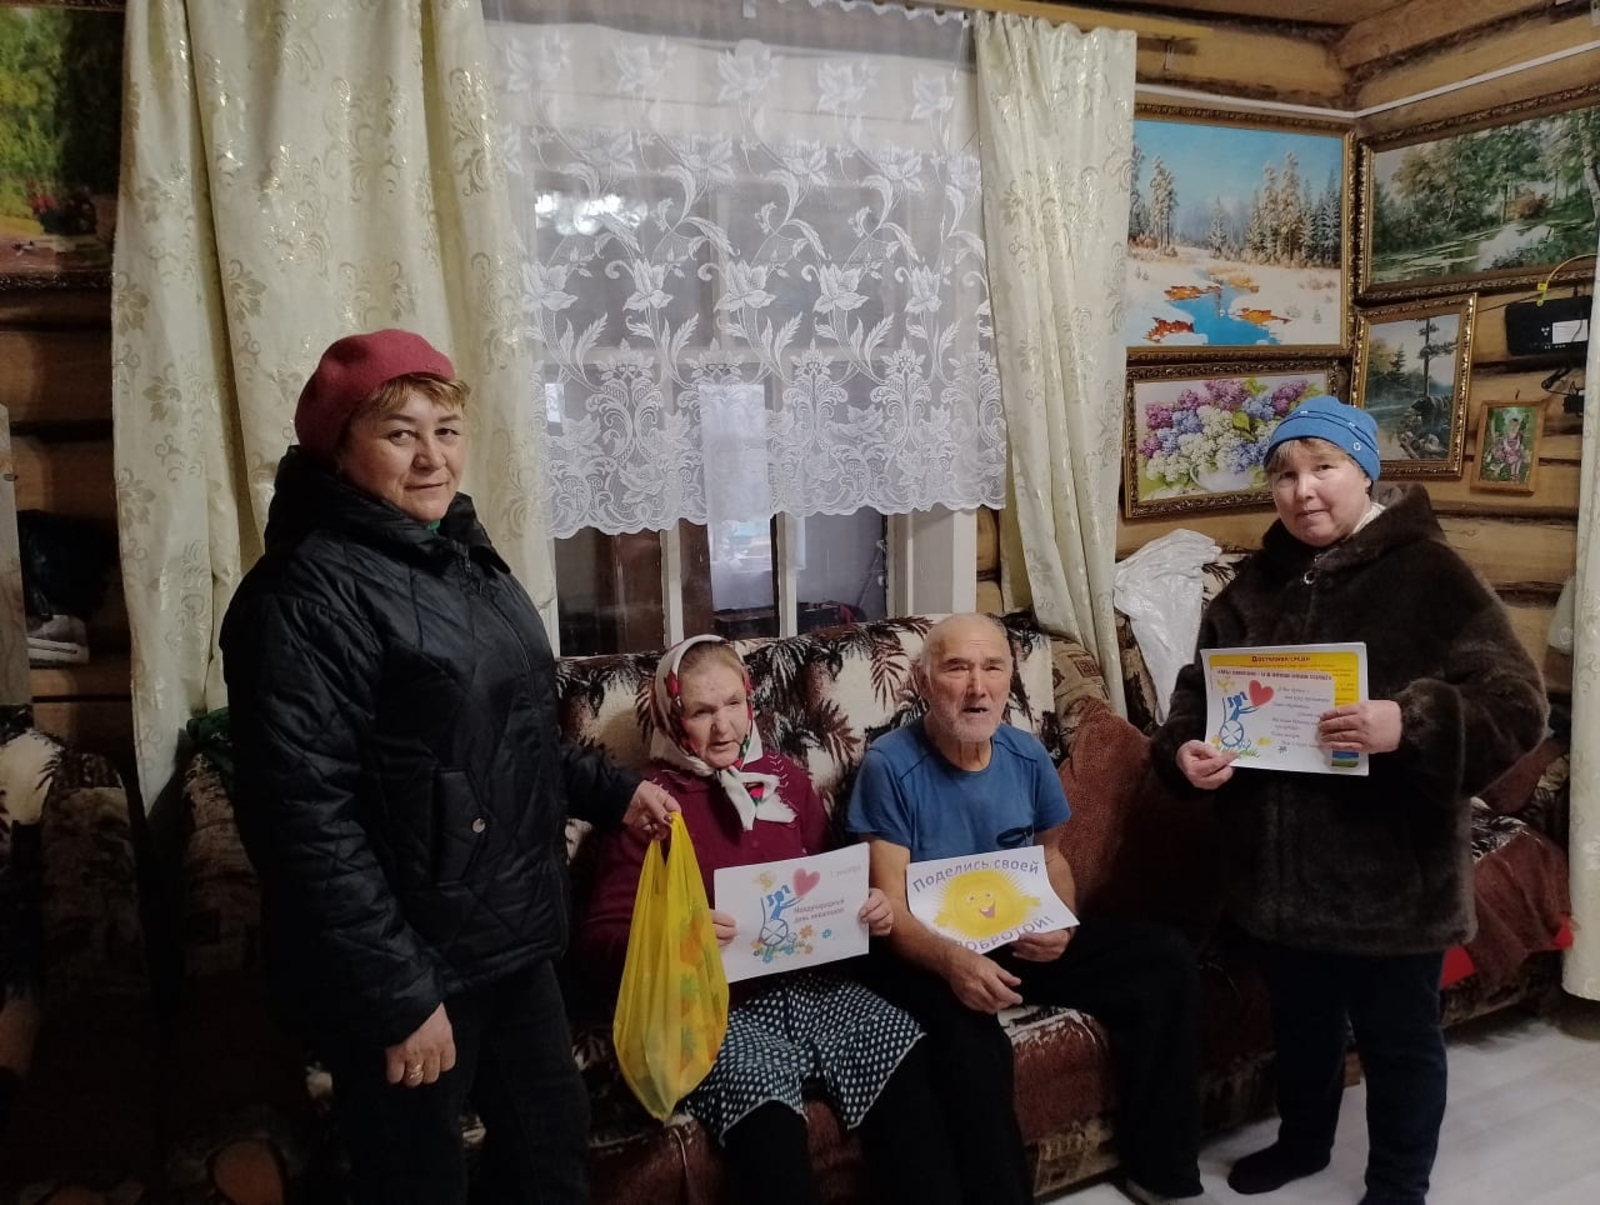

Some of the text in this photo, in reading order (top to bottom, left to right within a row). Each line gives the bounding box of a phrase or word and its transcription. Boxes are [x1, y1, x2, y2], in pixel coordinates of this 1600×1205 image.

[912, 859, 1040, 893] Поделись своей
[958, 915, 1055, 950] ОБРОТОЙ!
